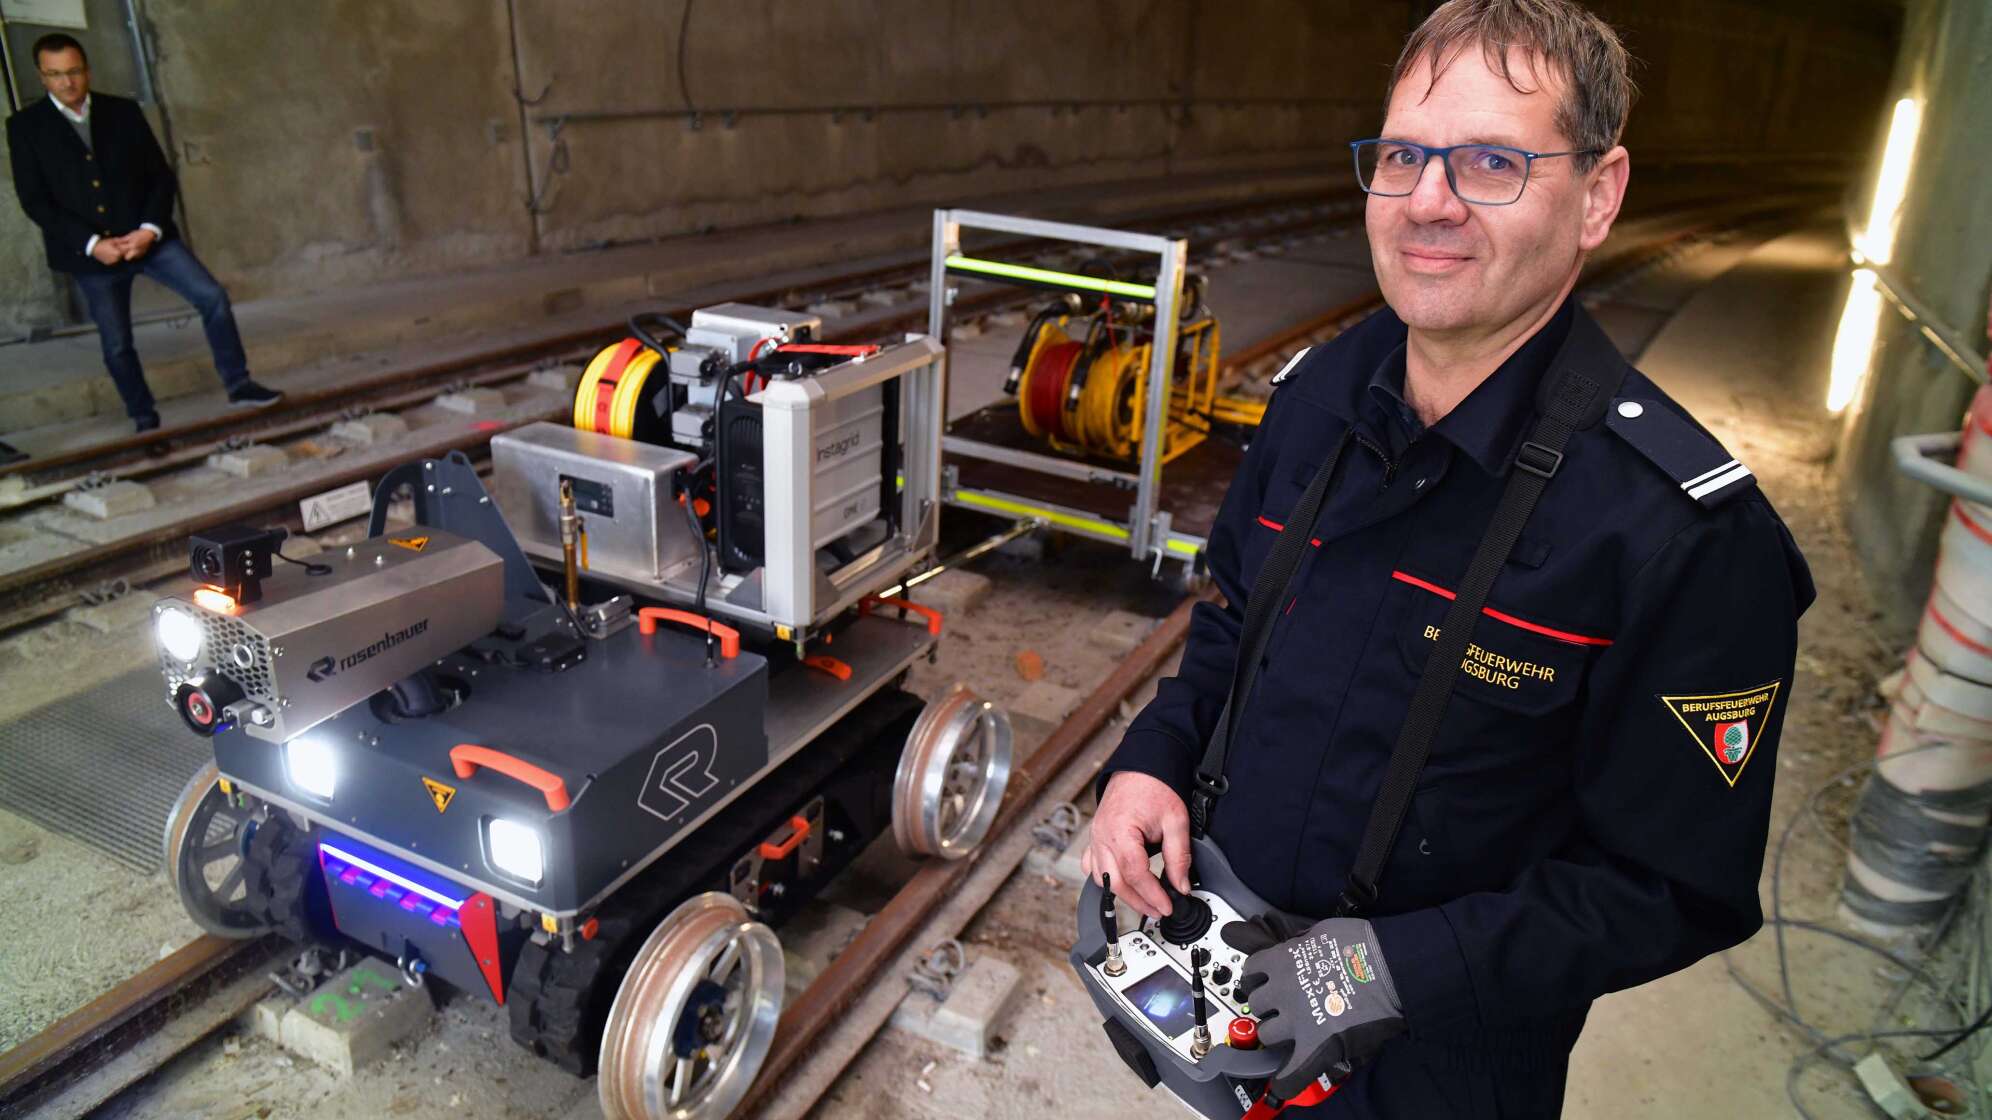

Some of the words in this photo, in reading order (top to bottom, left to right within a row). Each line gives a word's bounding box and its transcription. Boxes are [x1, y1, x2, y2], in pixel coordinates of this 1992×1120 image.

[340, 619, 429, 671] rosenbauer
[1424, 625, 1555, 682] BEFEUERWEHR
[1461, 658, 1521, 689] GSBURG
[1682, 693, 1769, 712] BERUFSFEUERWEHR
[1705, 707, 1756, 721] AUGSBURG
